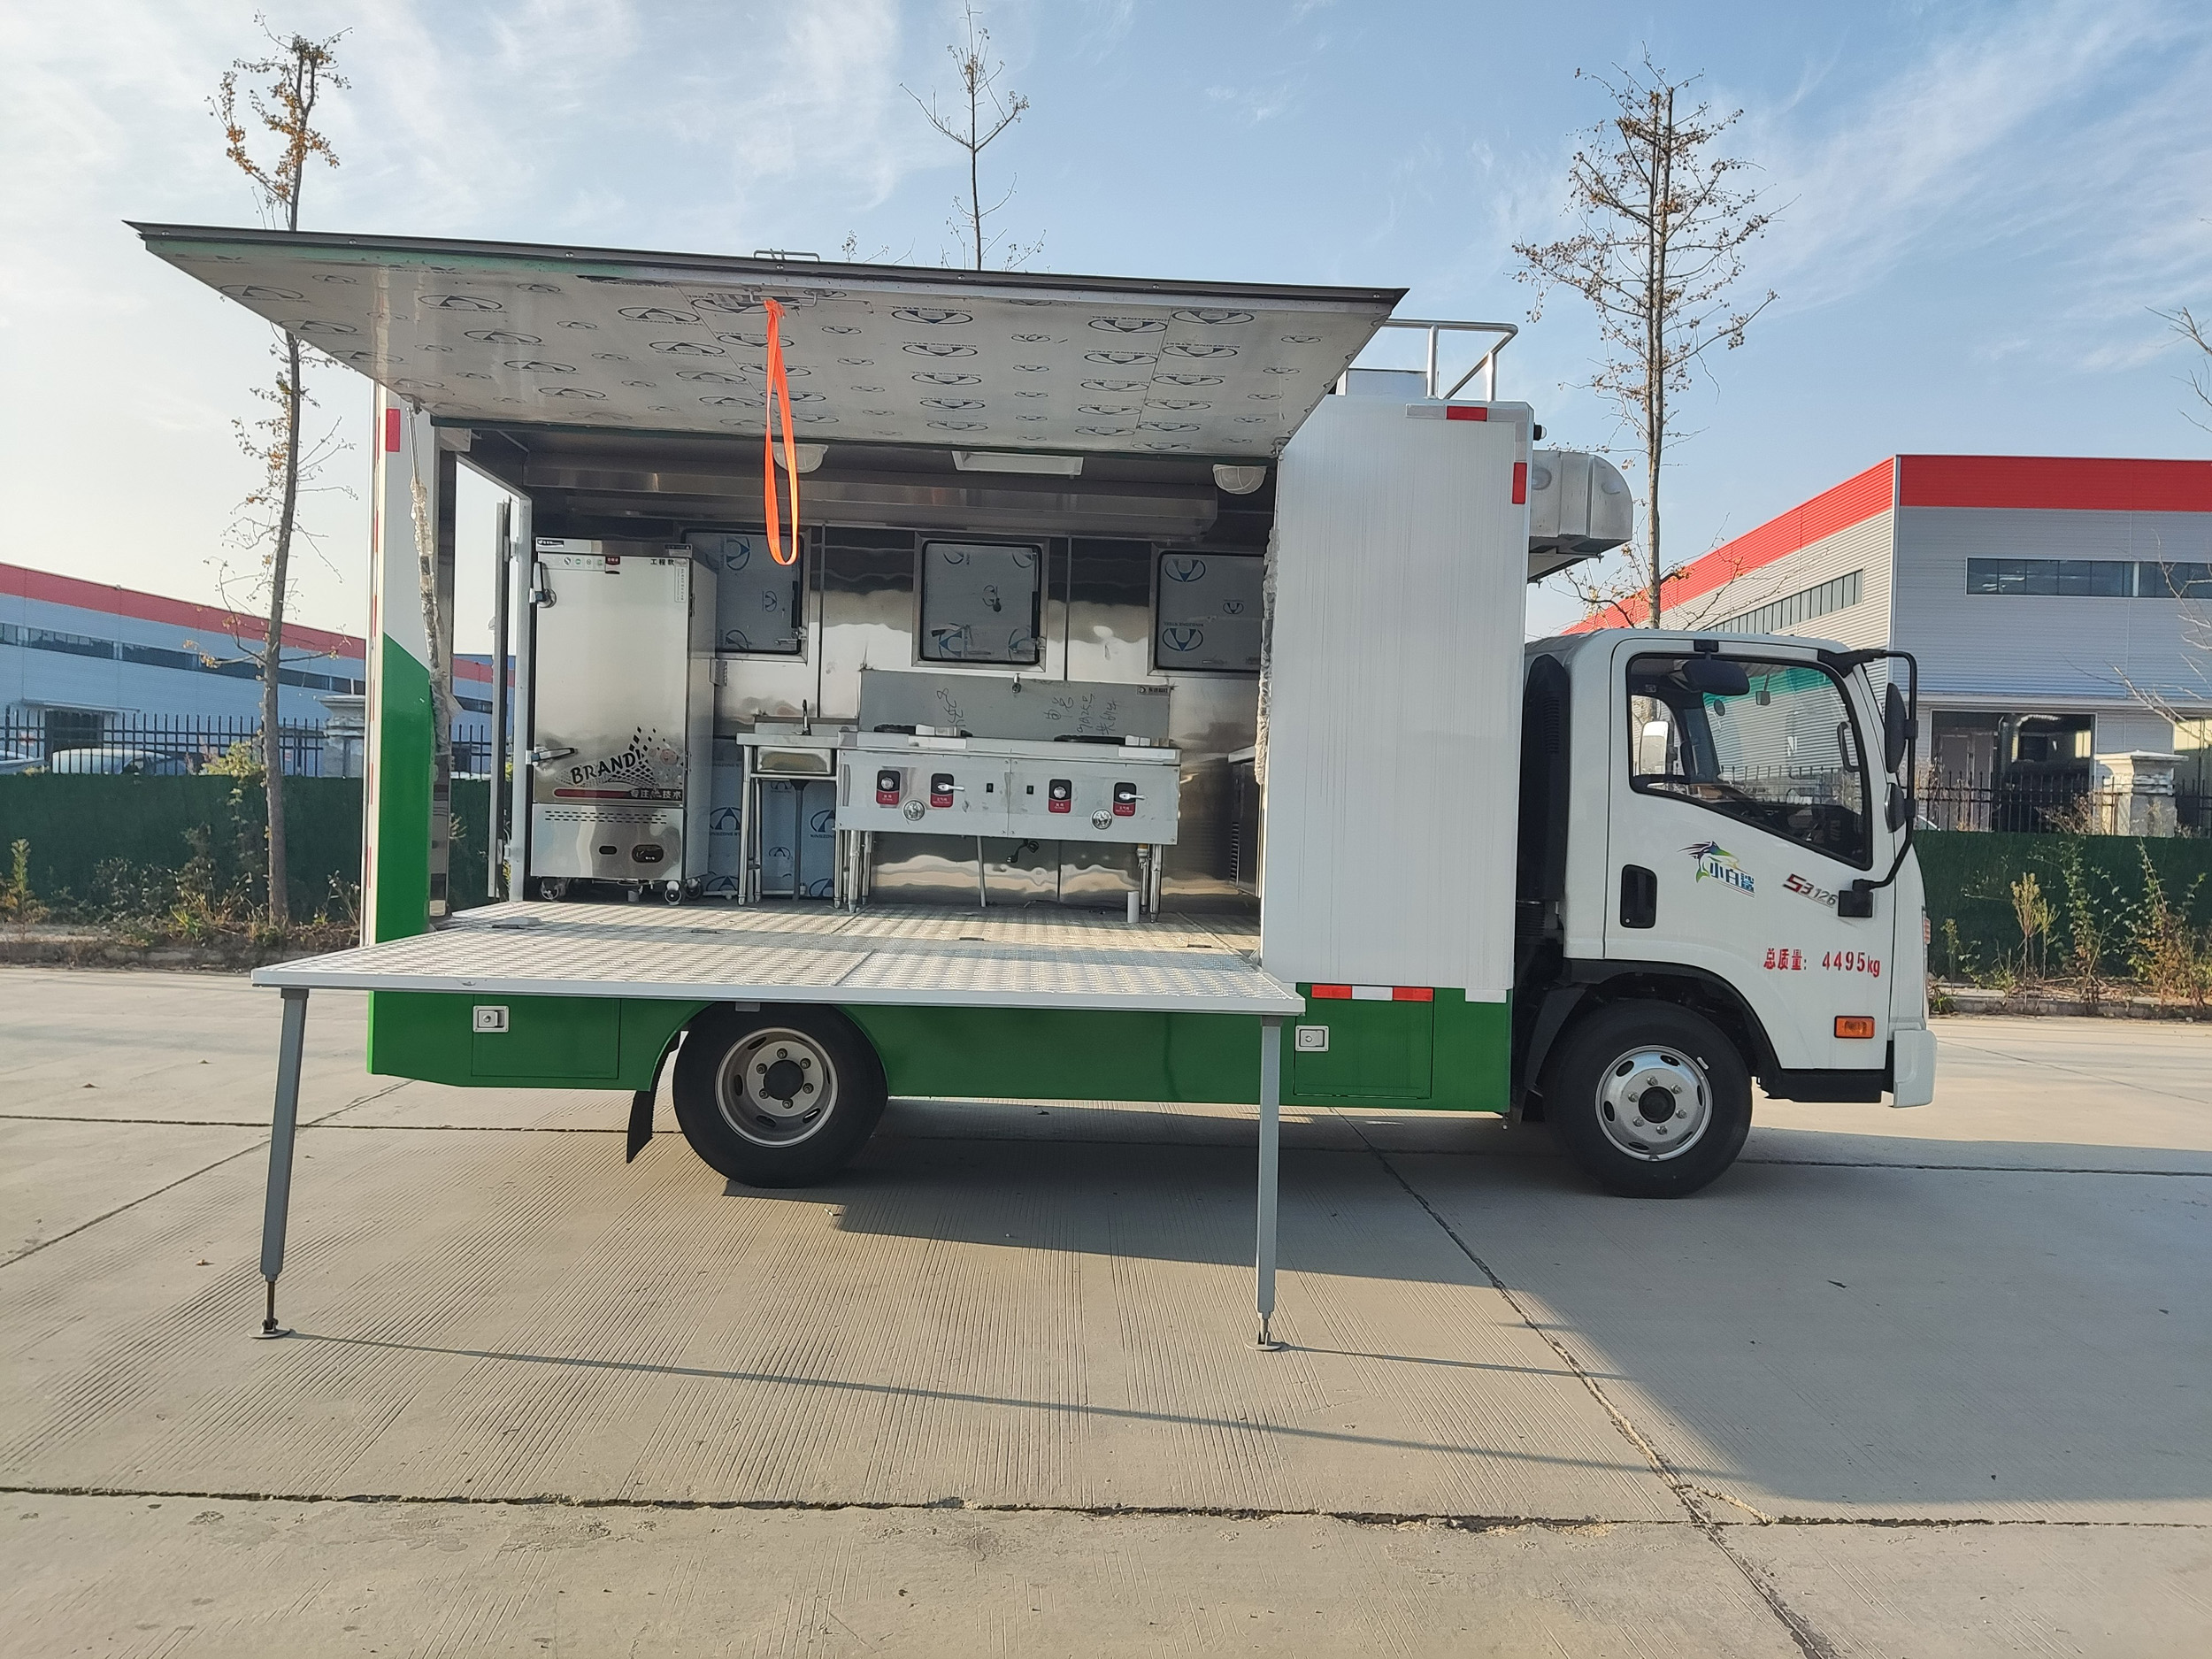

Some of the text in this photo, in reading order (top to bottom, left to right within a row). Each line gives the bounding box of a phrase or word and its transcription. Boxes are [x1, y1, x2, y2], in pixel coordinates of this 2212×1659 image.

[570, 749, 644, 785] BRAND!
[1709, 862, 1755, 894] 小白鲨
[1822, 950, 1881, 979] 4495kg
